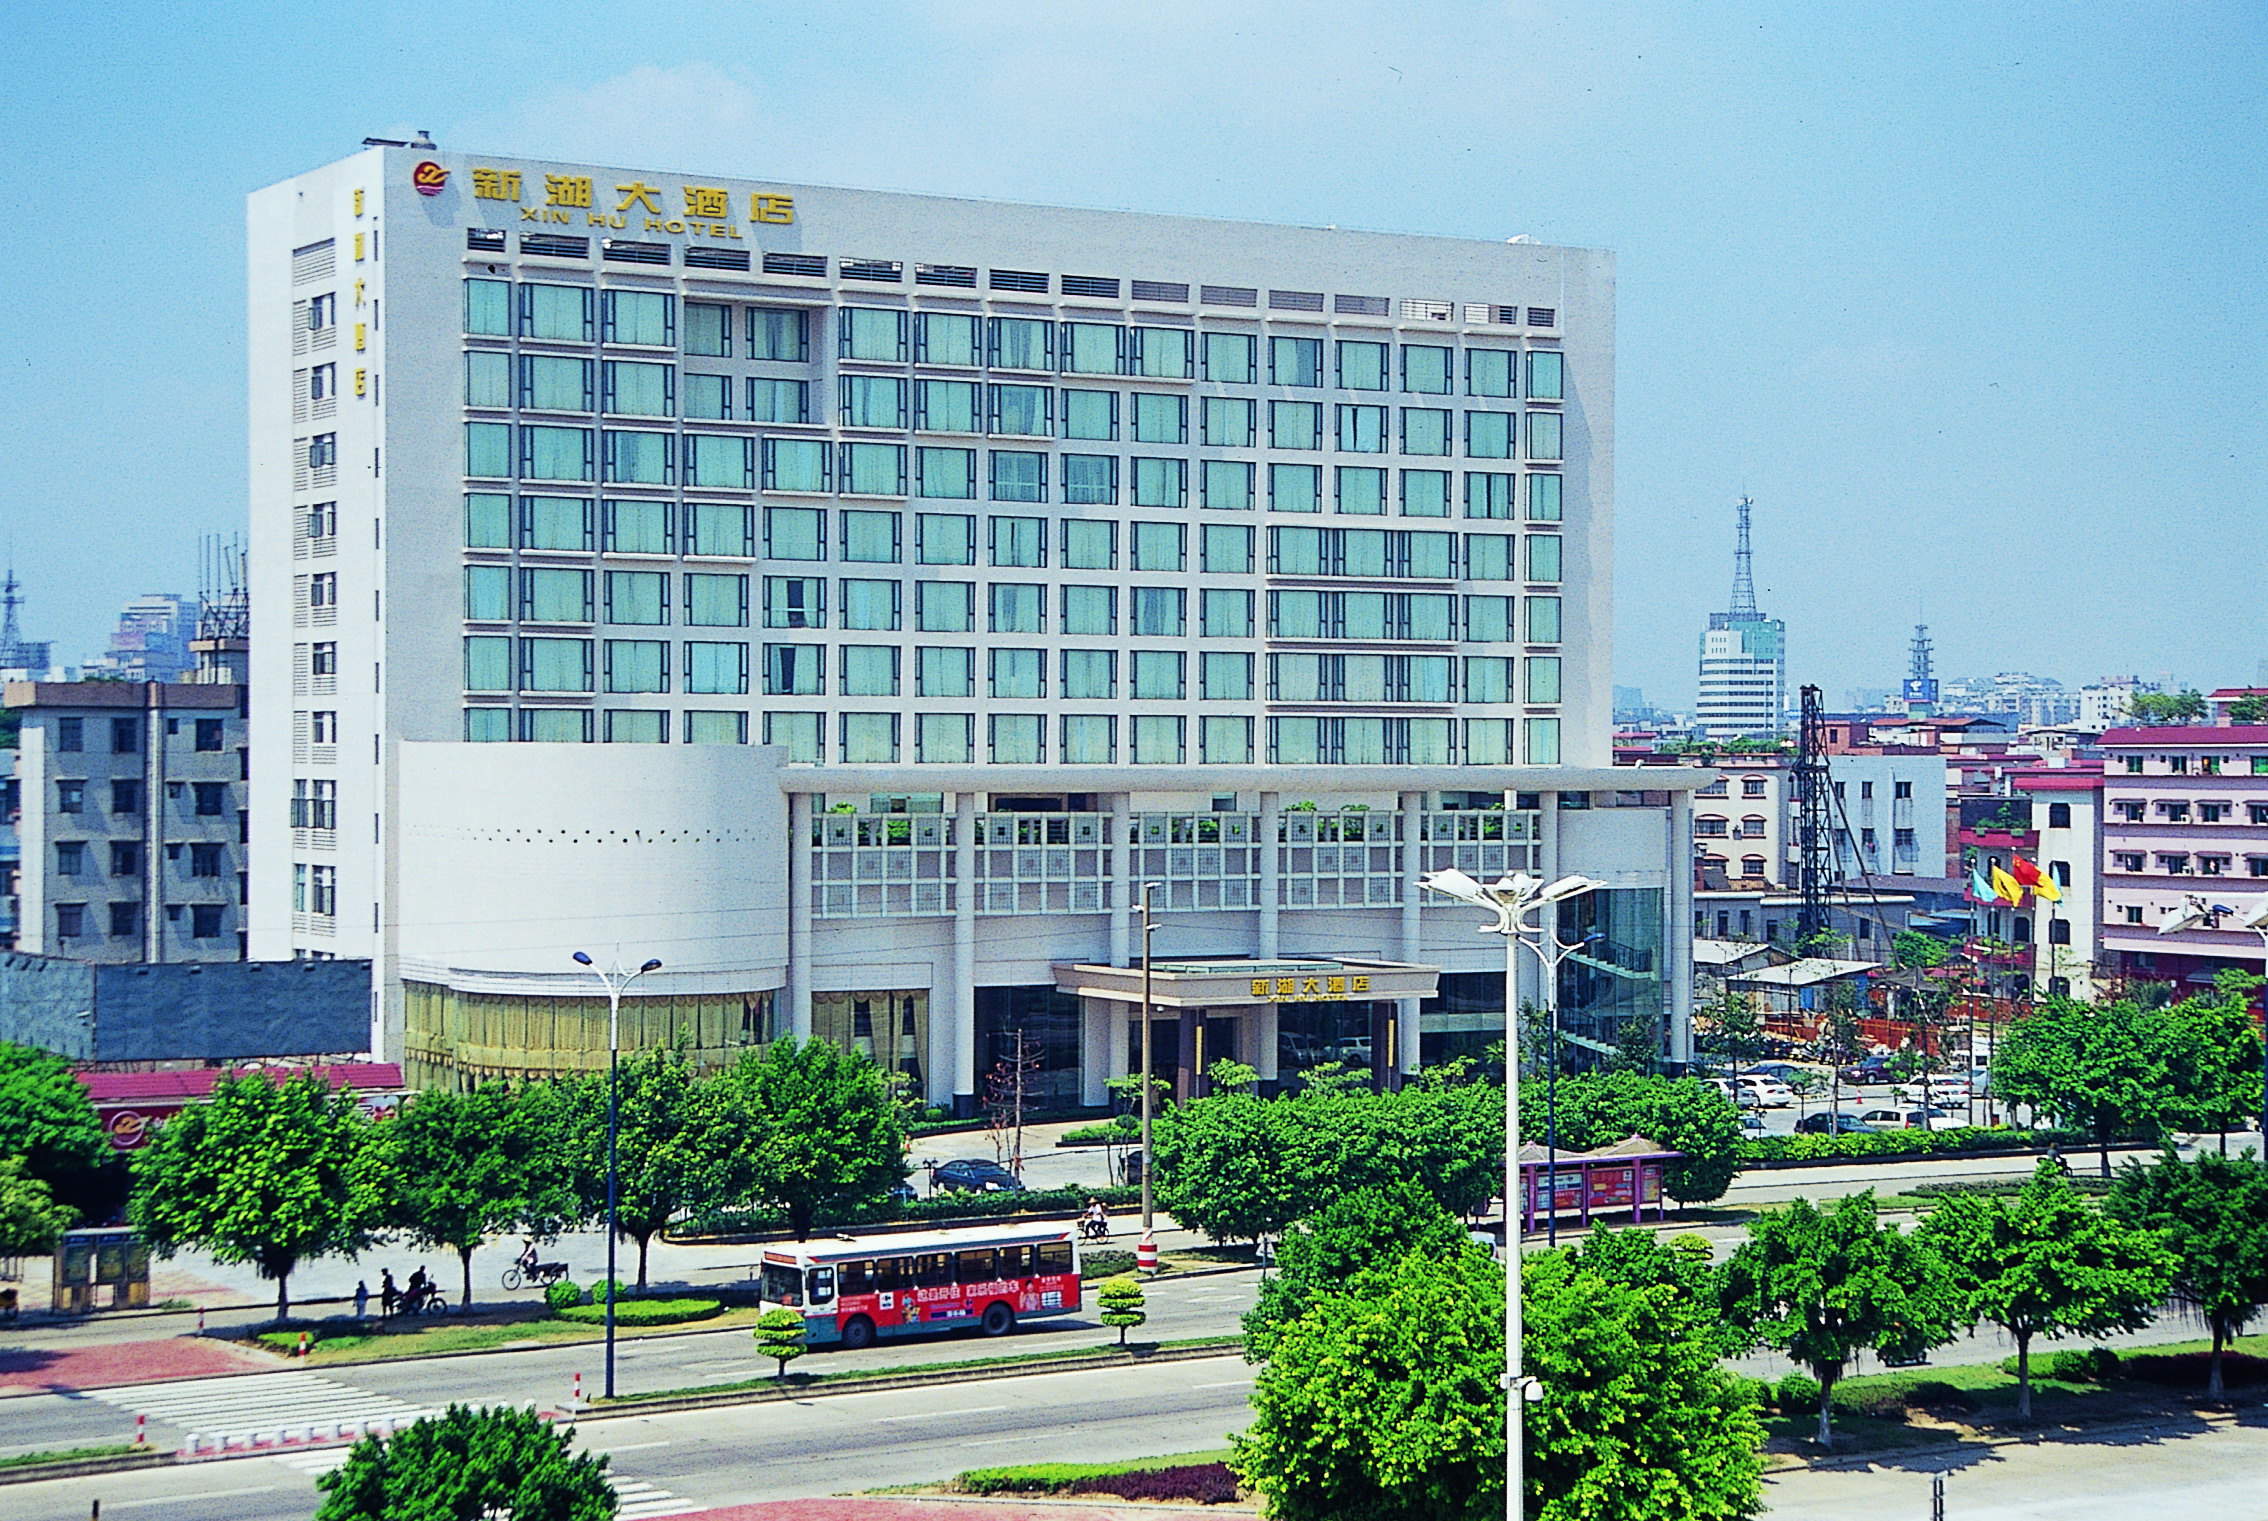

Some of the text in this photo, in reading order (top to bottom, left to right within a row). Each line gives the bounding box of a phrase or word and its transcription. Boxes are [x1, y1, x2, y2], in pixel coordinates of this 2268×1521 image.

[472, 168, 794, 224] 新湖大酒店
[520, 207, 743, 239] XIN HU HOTEL
[1251, 976, 1370, 995] 新湖大酒店
